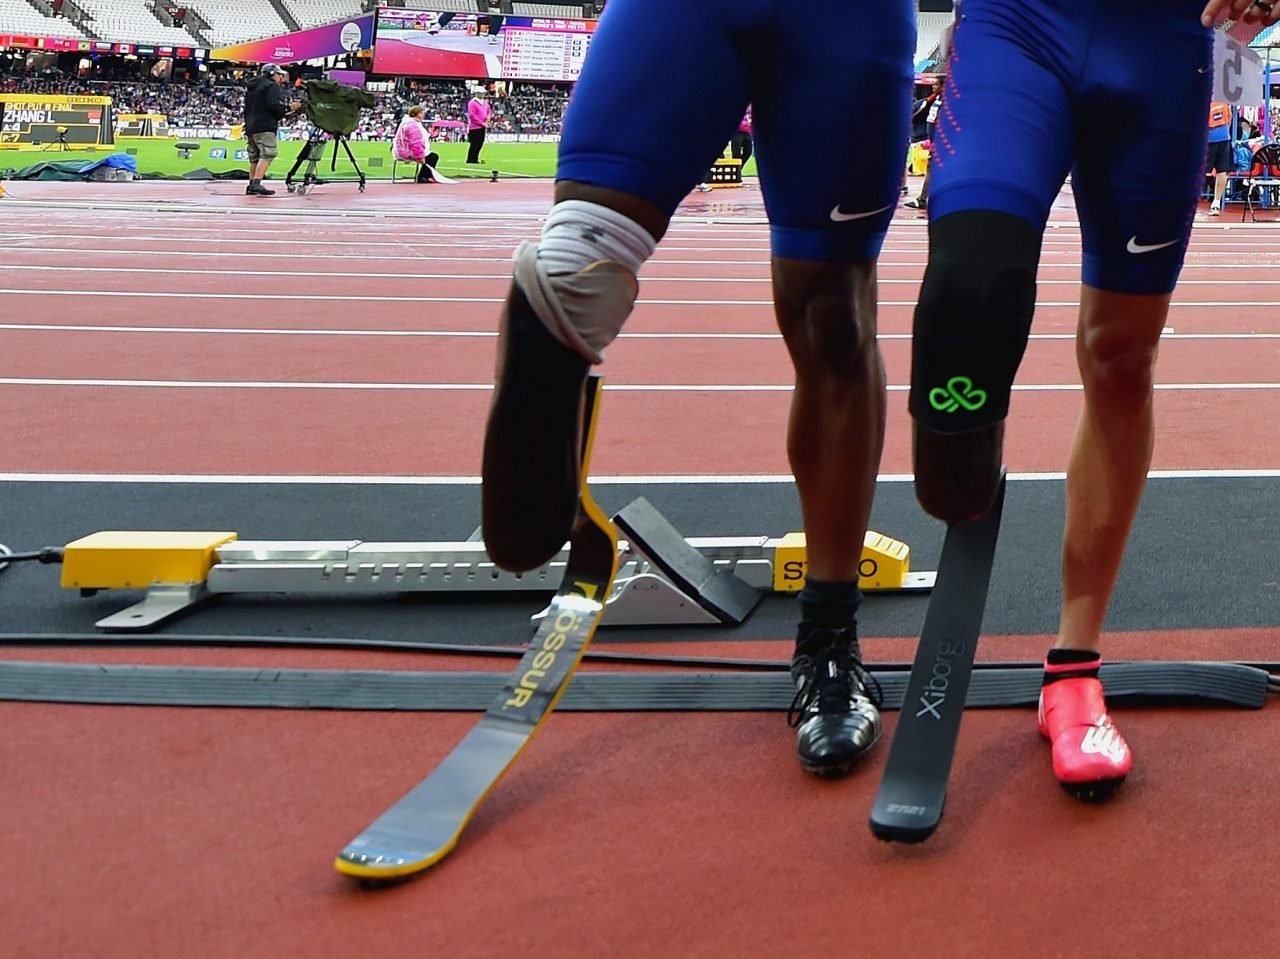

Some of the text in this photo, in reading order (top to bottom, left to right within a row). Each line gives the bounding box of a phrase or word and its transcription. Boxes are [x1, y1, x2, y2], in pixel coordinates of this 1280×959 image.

[66, 96, 102, 104] SEIKO
[5, 103, 27, 111] SHOT
[27, 103, 43, 111] PUT
[53, 104, 75, 112] FINAL
[3, 110, 56, 123] ZHANG L
[916, 640, 966, 720] Xiborg
